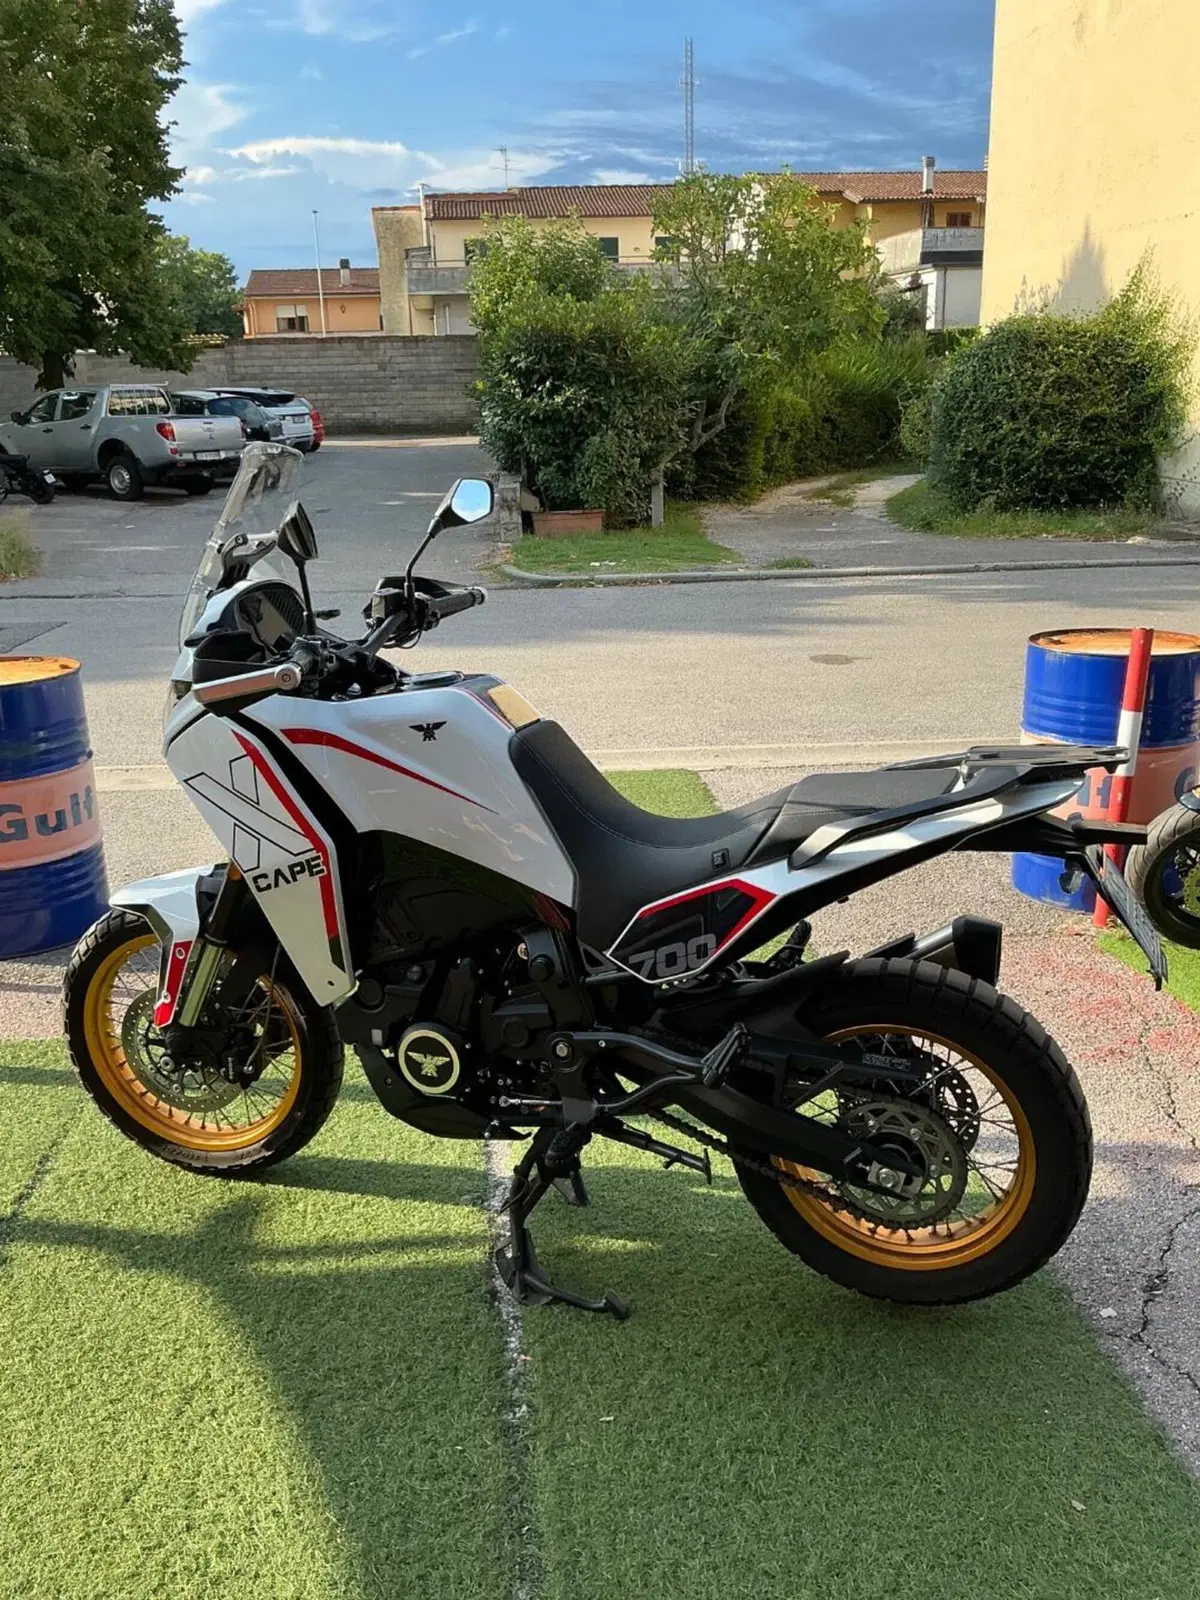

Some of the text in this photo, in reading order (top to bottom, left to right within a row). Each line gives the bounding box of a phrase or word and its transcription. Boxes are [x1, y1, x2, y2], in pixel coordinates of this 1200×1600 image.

[0, 785, 93, 843] Gulf
[252, 854, 326, 893] CAPE
[628, 932, 717, 978] 700
